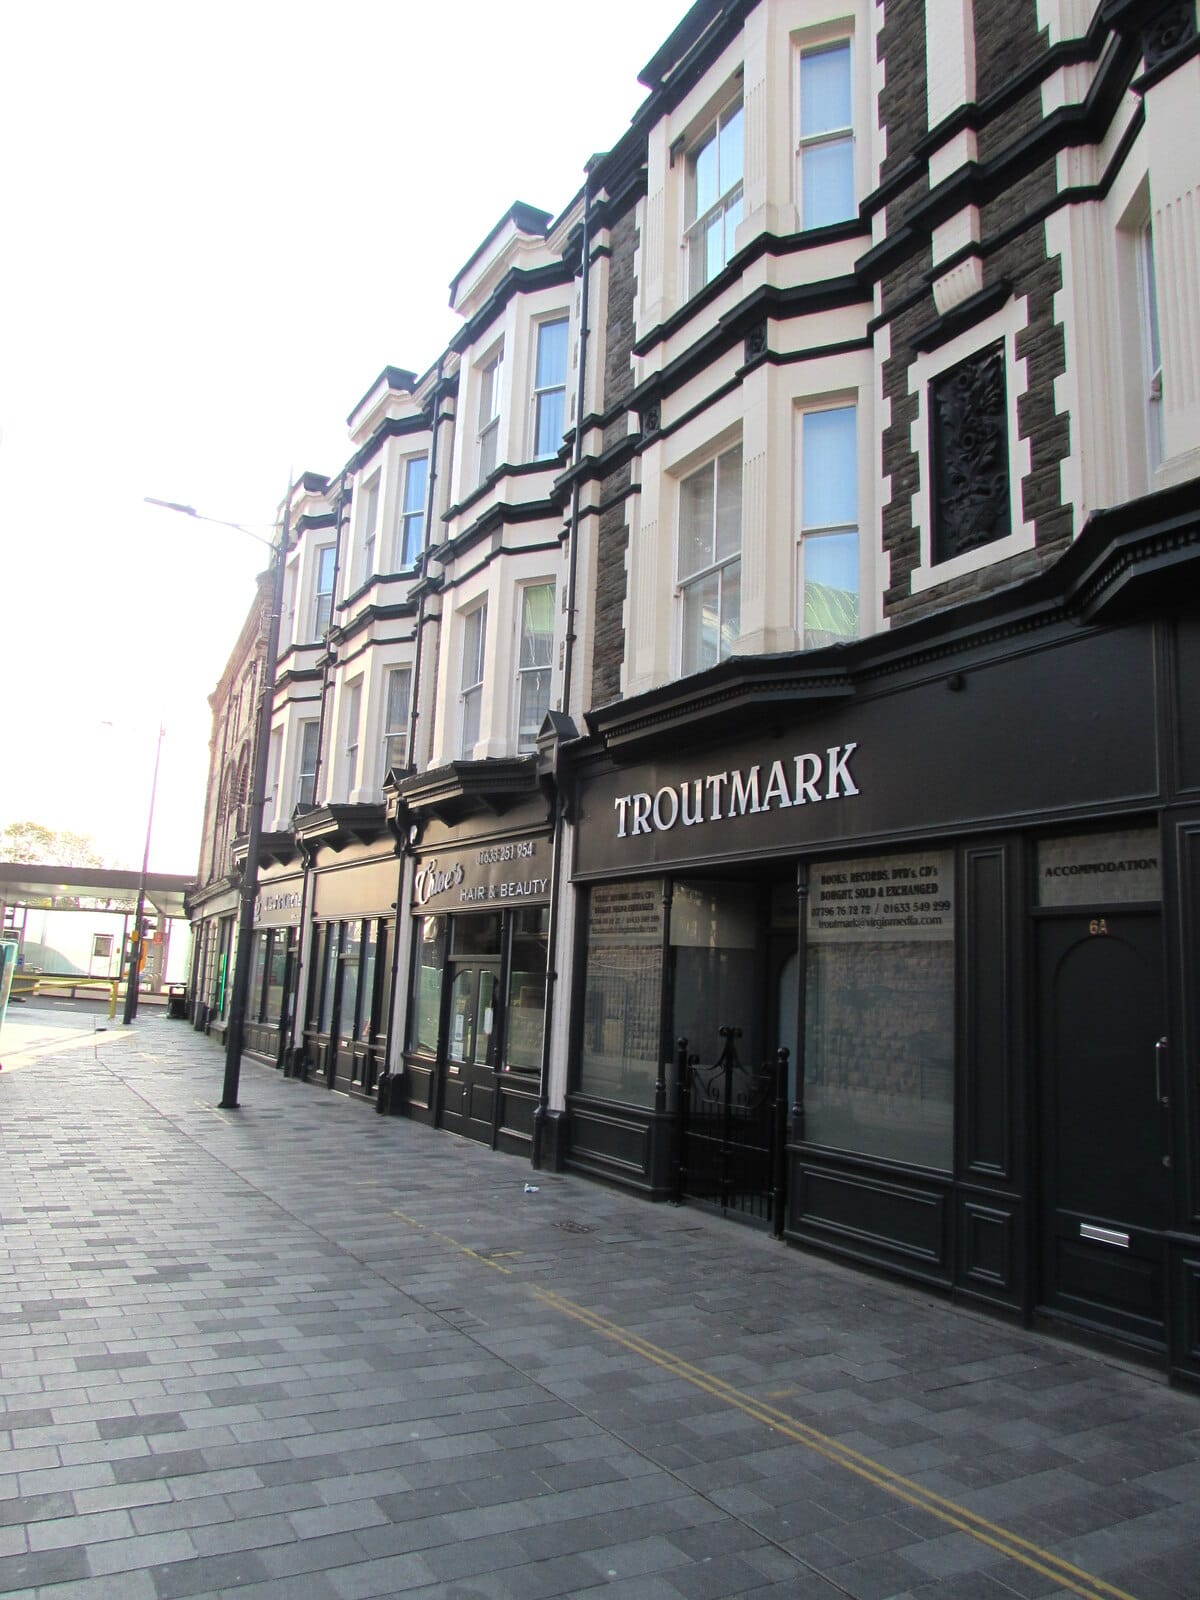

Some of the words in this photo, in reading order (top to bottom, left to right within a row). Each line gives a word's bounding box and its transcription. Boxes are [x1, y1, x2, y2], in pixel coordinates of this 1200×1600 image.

[614, 742, 859, 838] TROUTMARK
[517, 842, 533, 858] 954
[1044, 858, 1158, 878] ACCOMMODATION
[460, 886, 485, 901] HAIR
[488, 885, 496, 899] &
[500, 879, 548, 898] BEAUTY
[855, 887, 876, 899] SOLD
[878, 886, 885, 898] &
[886, 883, 939, 897] EXCHANGED
[836, 905, 845, 916] 76
[883, 902, 911, 914] 01633
[913, 901, 930, 912] 549
[1089, 919, 1109, 935] 6A
